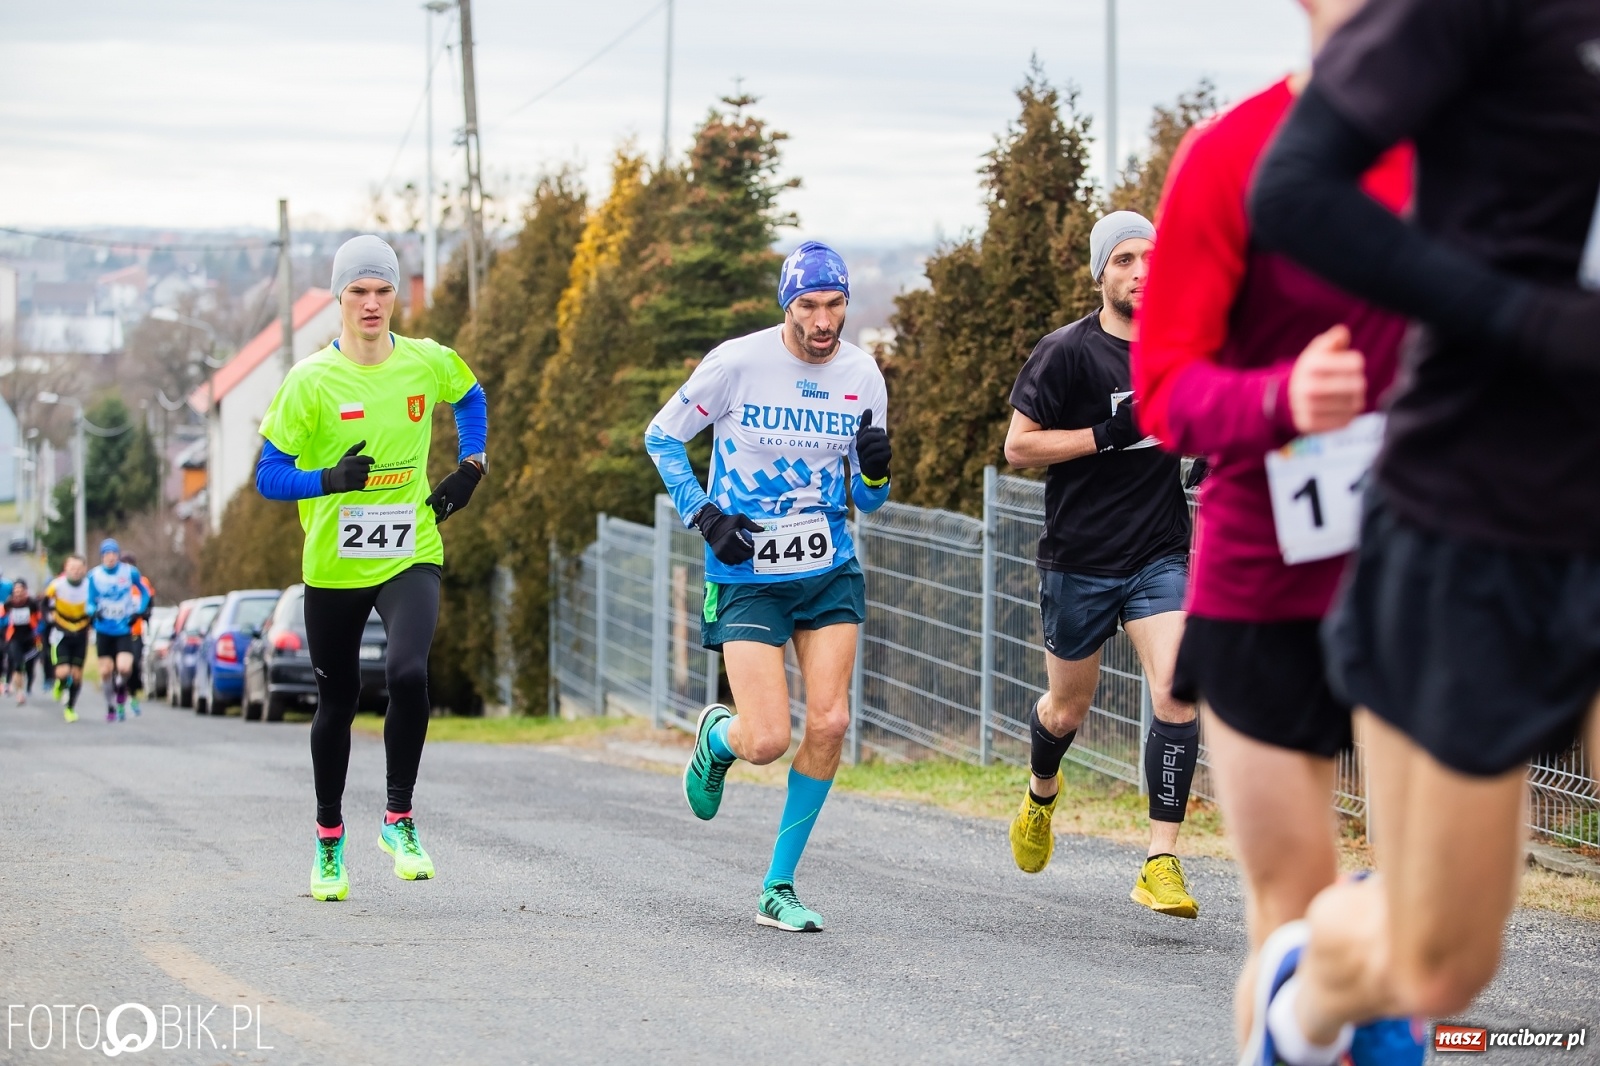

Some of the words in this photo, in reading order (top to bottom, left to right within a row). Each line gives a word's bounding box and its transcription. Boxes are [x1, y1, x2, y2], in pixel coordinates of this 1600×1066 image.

[760, 437, 819, 449] EKO-OKNA
[367, 509, 413, 517] www.personalbest.pl
[342, 524, 412, 549] 247
[757, 532, 828, 564] 449
